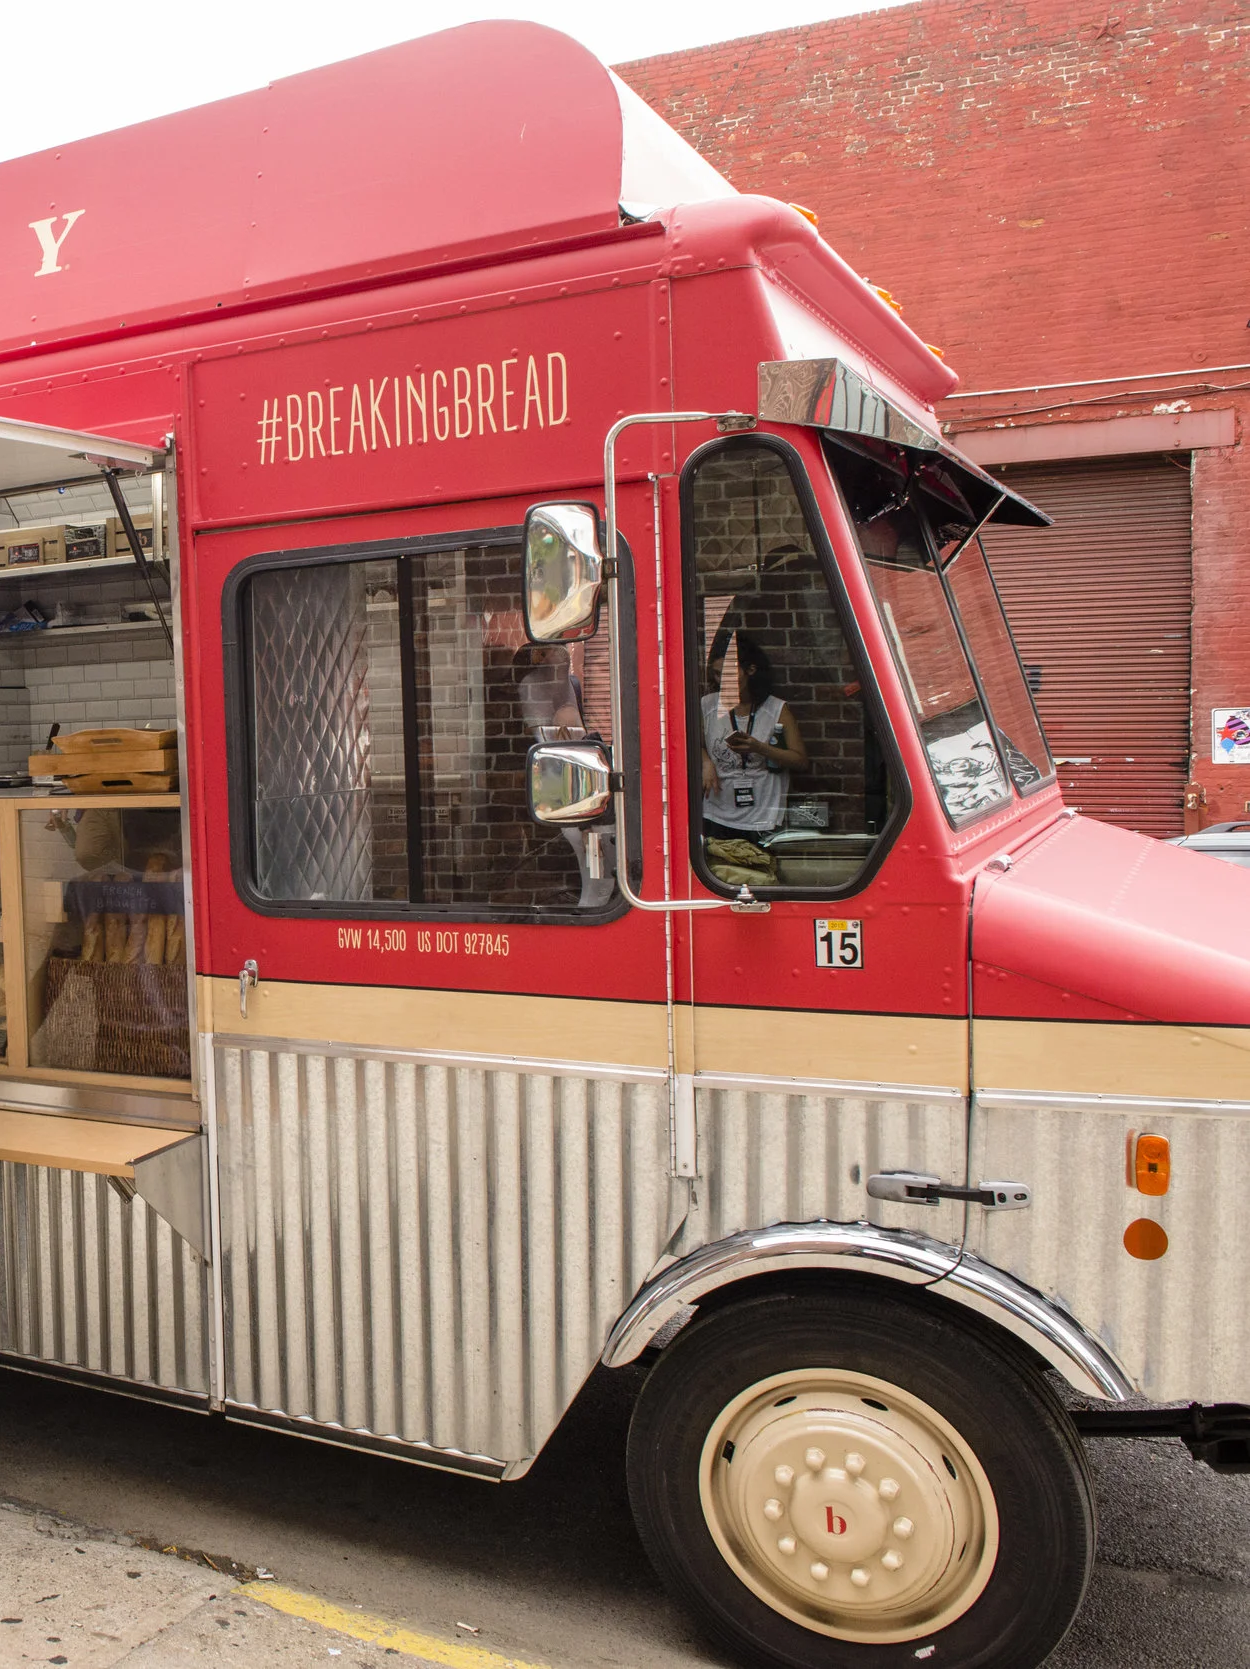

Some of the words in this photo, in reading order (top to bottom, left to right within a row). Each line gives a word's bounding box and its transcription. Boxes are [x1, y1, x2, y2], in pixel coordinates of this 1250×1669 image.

[256, 351, 568, 465] #BREAKINGBREAD
[337, 927, 362, 949] GVW
[366, 928, 407, 953] 14,500
[417, 930, 431, 953] US
[436, 931, 460, 953] DOT
[464, 932, 510, 957] 927845
[820, 931, 859, 966] 15
[825, 1506, 847, 1536] b
